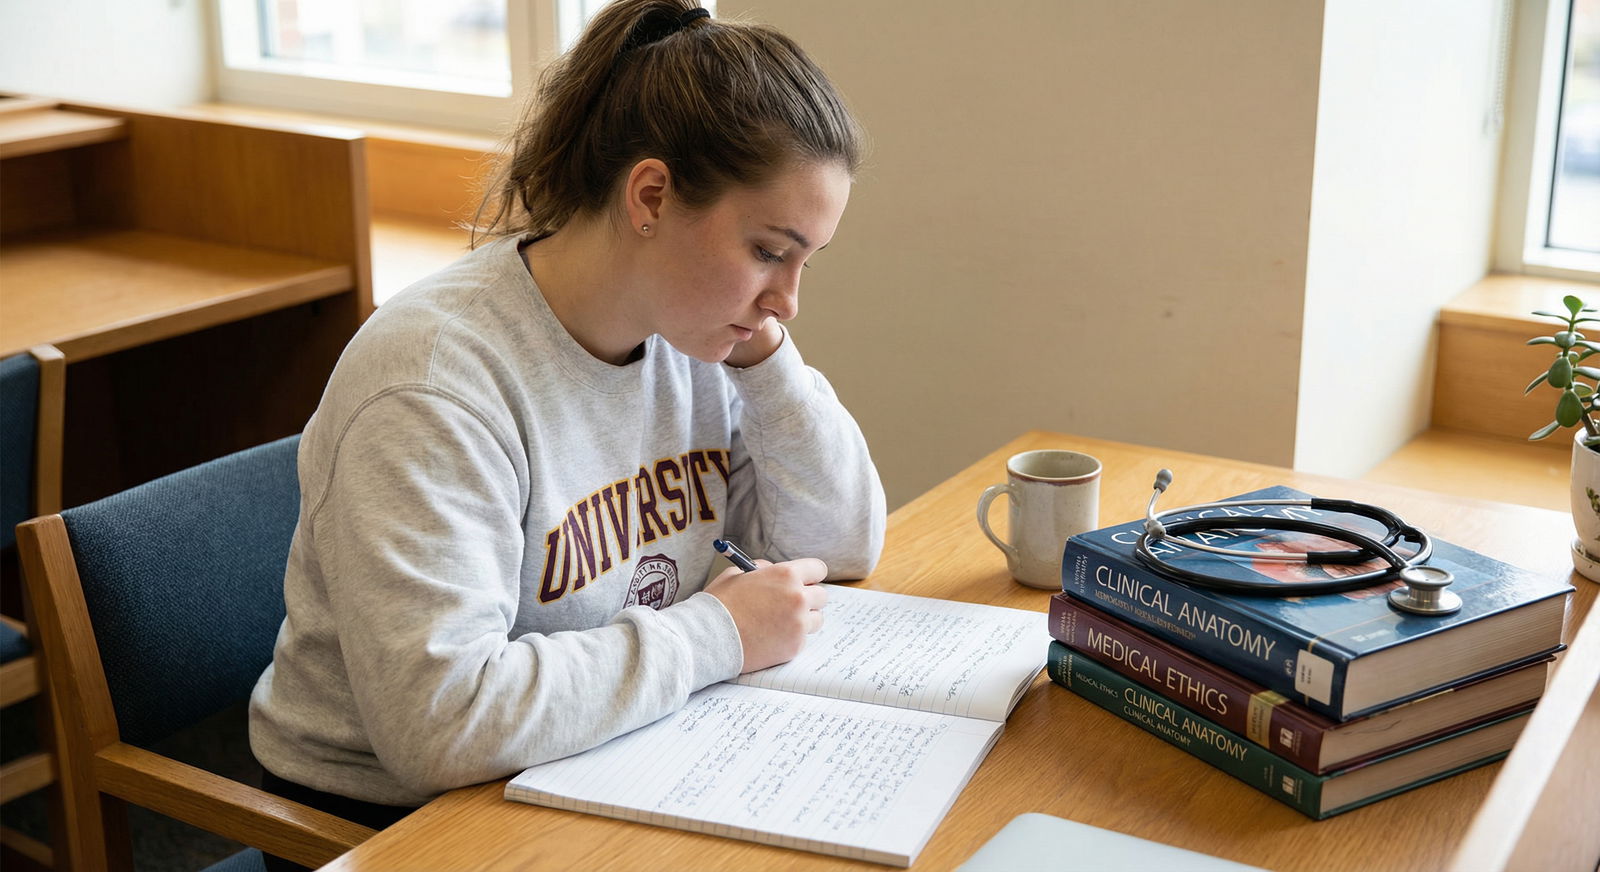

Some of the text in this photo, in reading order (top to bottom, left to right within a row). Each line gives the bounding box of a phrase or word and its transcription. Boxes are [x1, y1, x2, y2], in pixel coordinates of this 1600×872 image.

[1096, 565, 1173, 617] CLINICAL
[1177, 602, 1276, 661] ANATOMY
[1087, 627, 1162, 683] MEDICAL
[1166, 666, 1229, 716] ETHICS
[1123, 705, 1156, 728] CLINICAL
[1124, 687, 1179, 727] CLINICAL
[1182, 717, 1248, 761] ANATOMY
